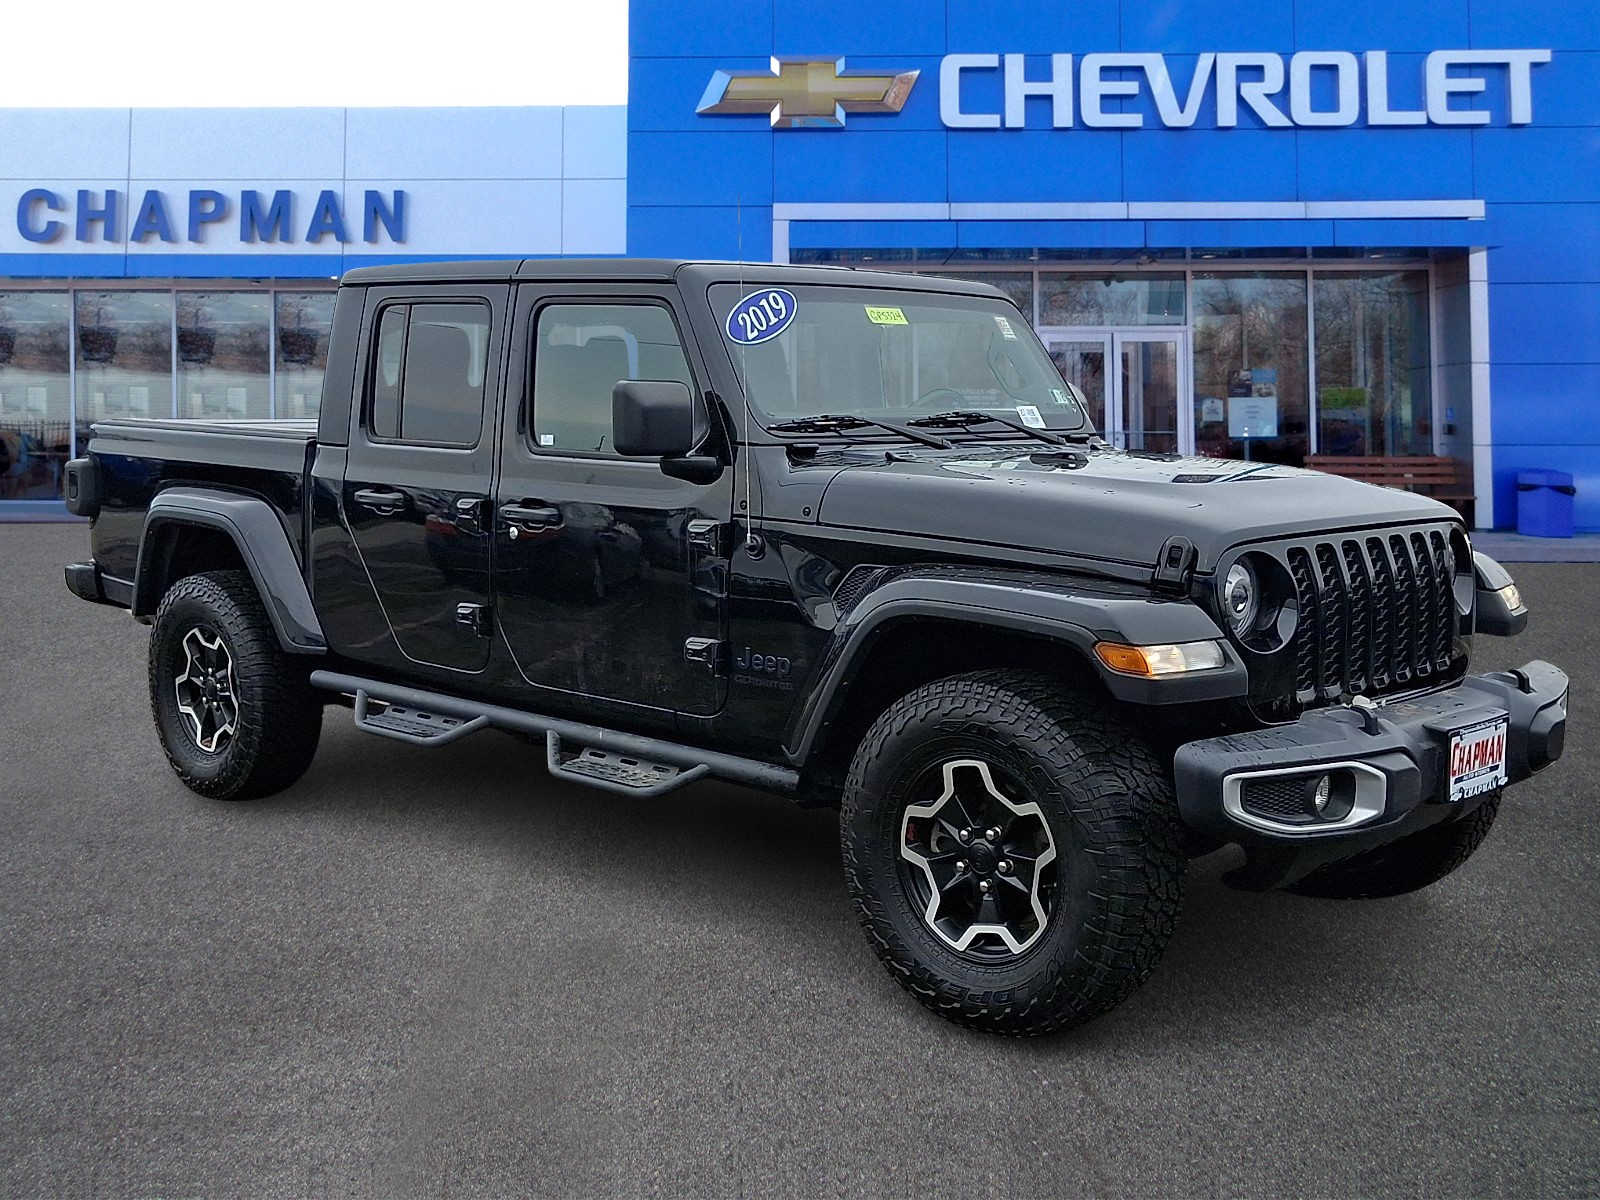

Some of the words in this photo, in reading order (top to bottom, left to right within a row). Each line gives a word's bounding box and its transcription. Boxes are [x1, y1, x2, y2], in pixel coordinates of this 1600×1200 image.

[939, 49, 1552, 128] CHEVROLET
[16, 188, 407, 243] CHAPMAN
[737, 292, 787, 340] 2019
[736, 646, 792, 678] Jeep
[1451, 734, 1504, 776] CHAPMAN
[1463, 777, 1498, 798] CHAPMAN
